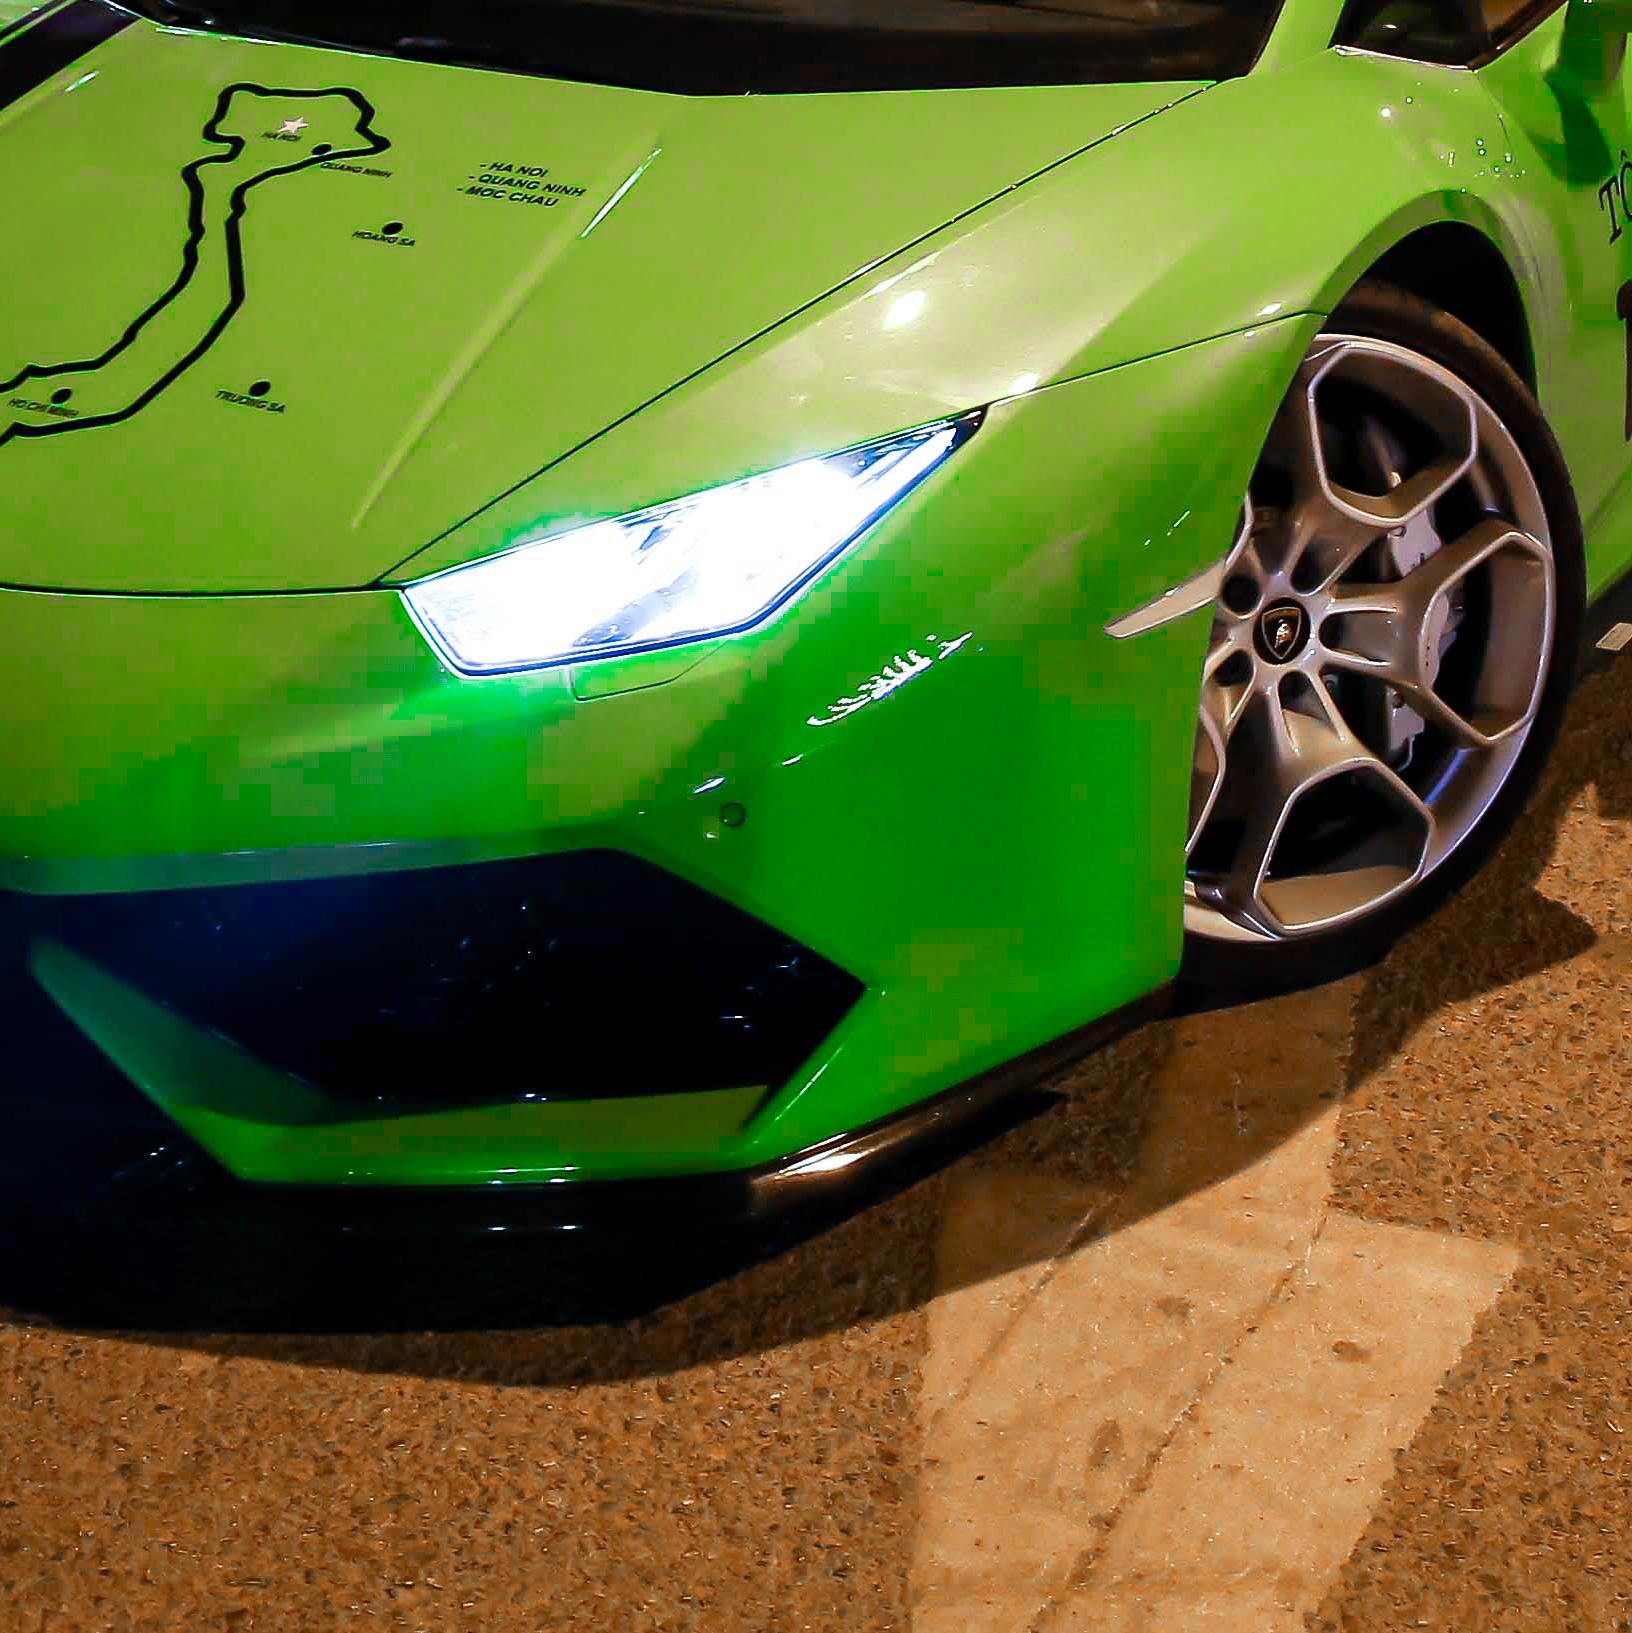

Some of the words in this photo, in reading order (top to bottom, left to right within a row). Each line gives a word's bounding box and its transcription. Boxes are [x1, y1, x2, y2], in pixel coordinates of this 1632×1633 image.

[489, 162, 513, 173] HA
[516, 166, 548, 178] NOI
[478, 174, 541, 191] QUANG
[542, 183, 587, 197] NINH
[465, 186, 506, 199] MOC
[509, 192, 560, 207] CHAU
